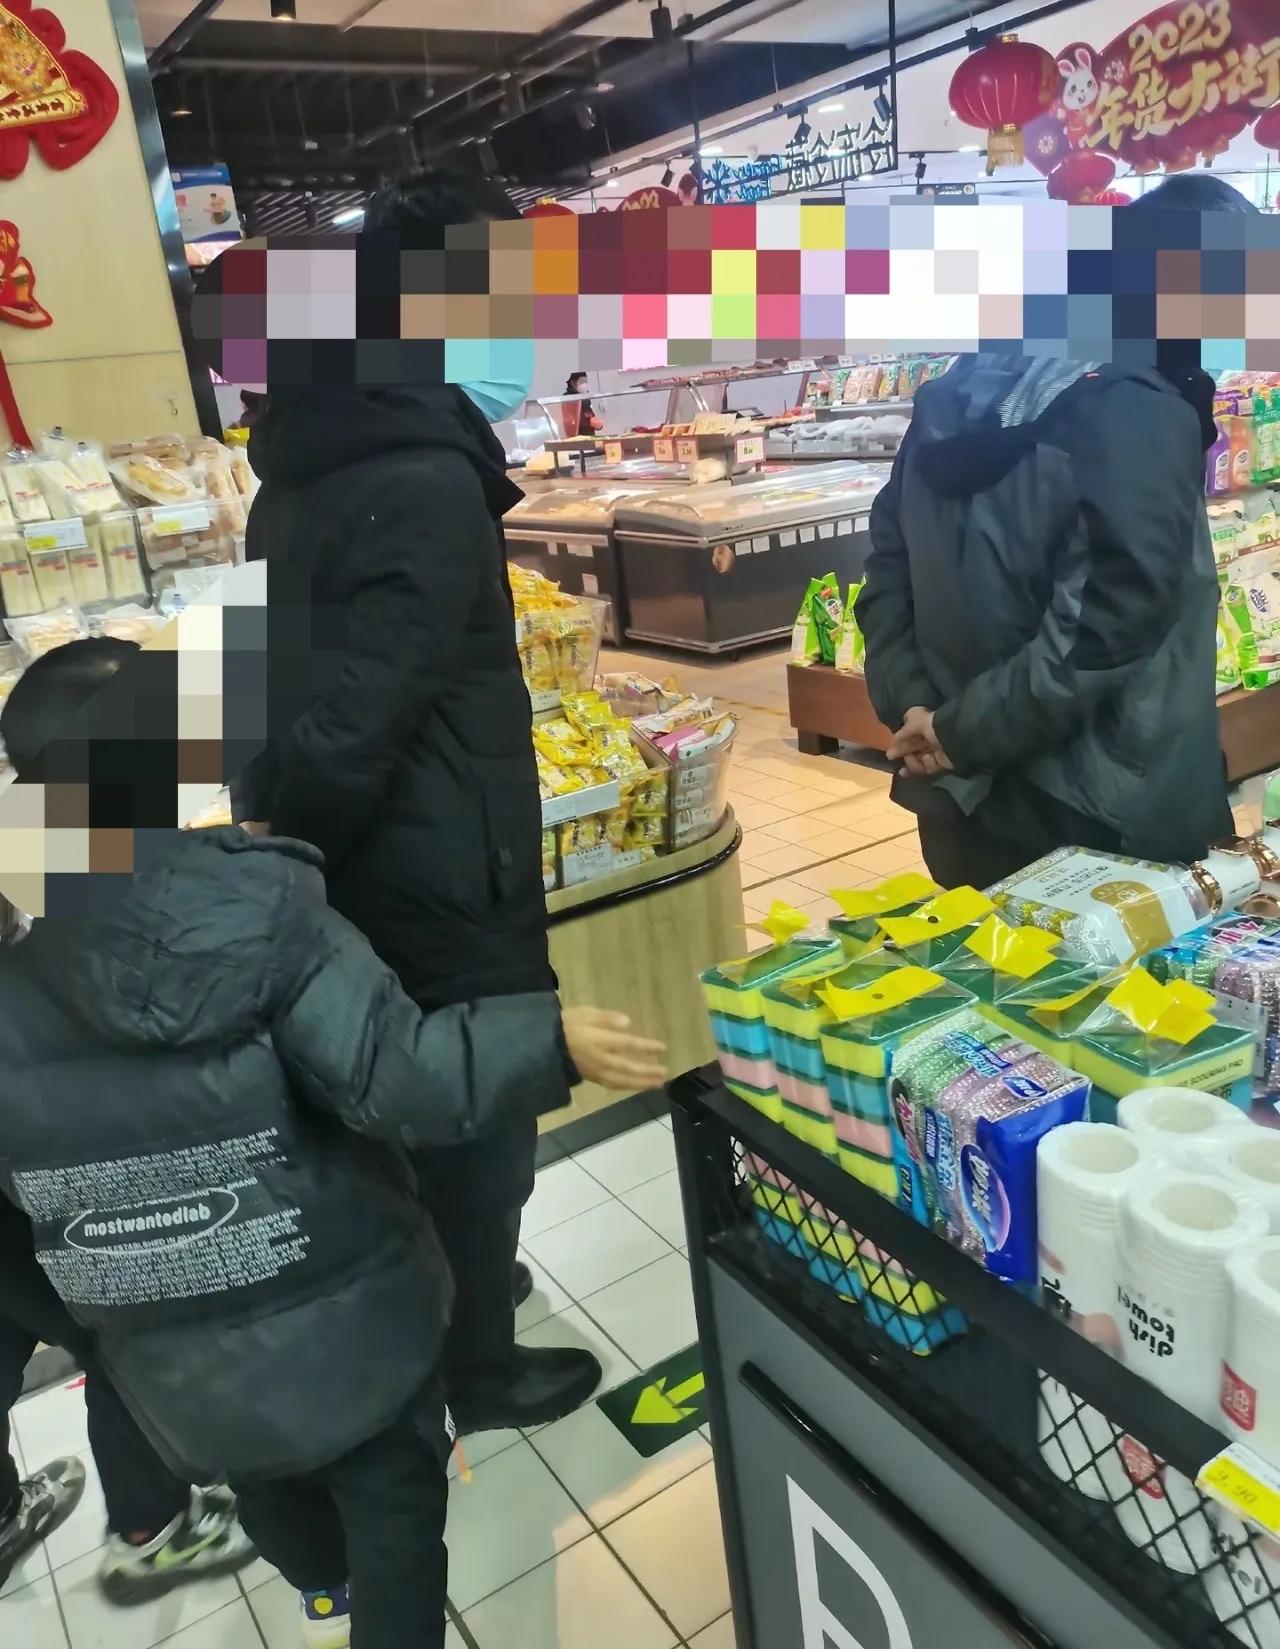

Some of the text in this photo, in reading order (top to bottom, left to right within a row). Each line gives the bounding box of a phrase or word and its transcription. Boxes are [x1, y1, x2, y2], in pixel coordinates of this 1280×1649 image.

[1127, 1, 1232, 69] 2023
[84, 1203, 211, 1237] mostwantedlab
[1129, 1318, 1174, 1358] dish
